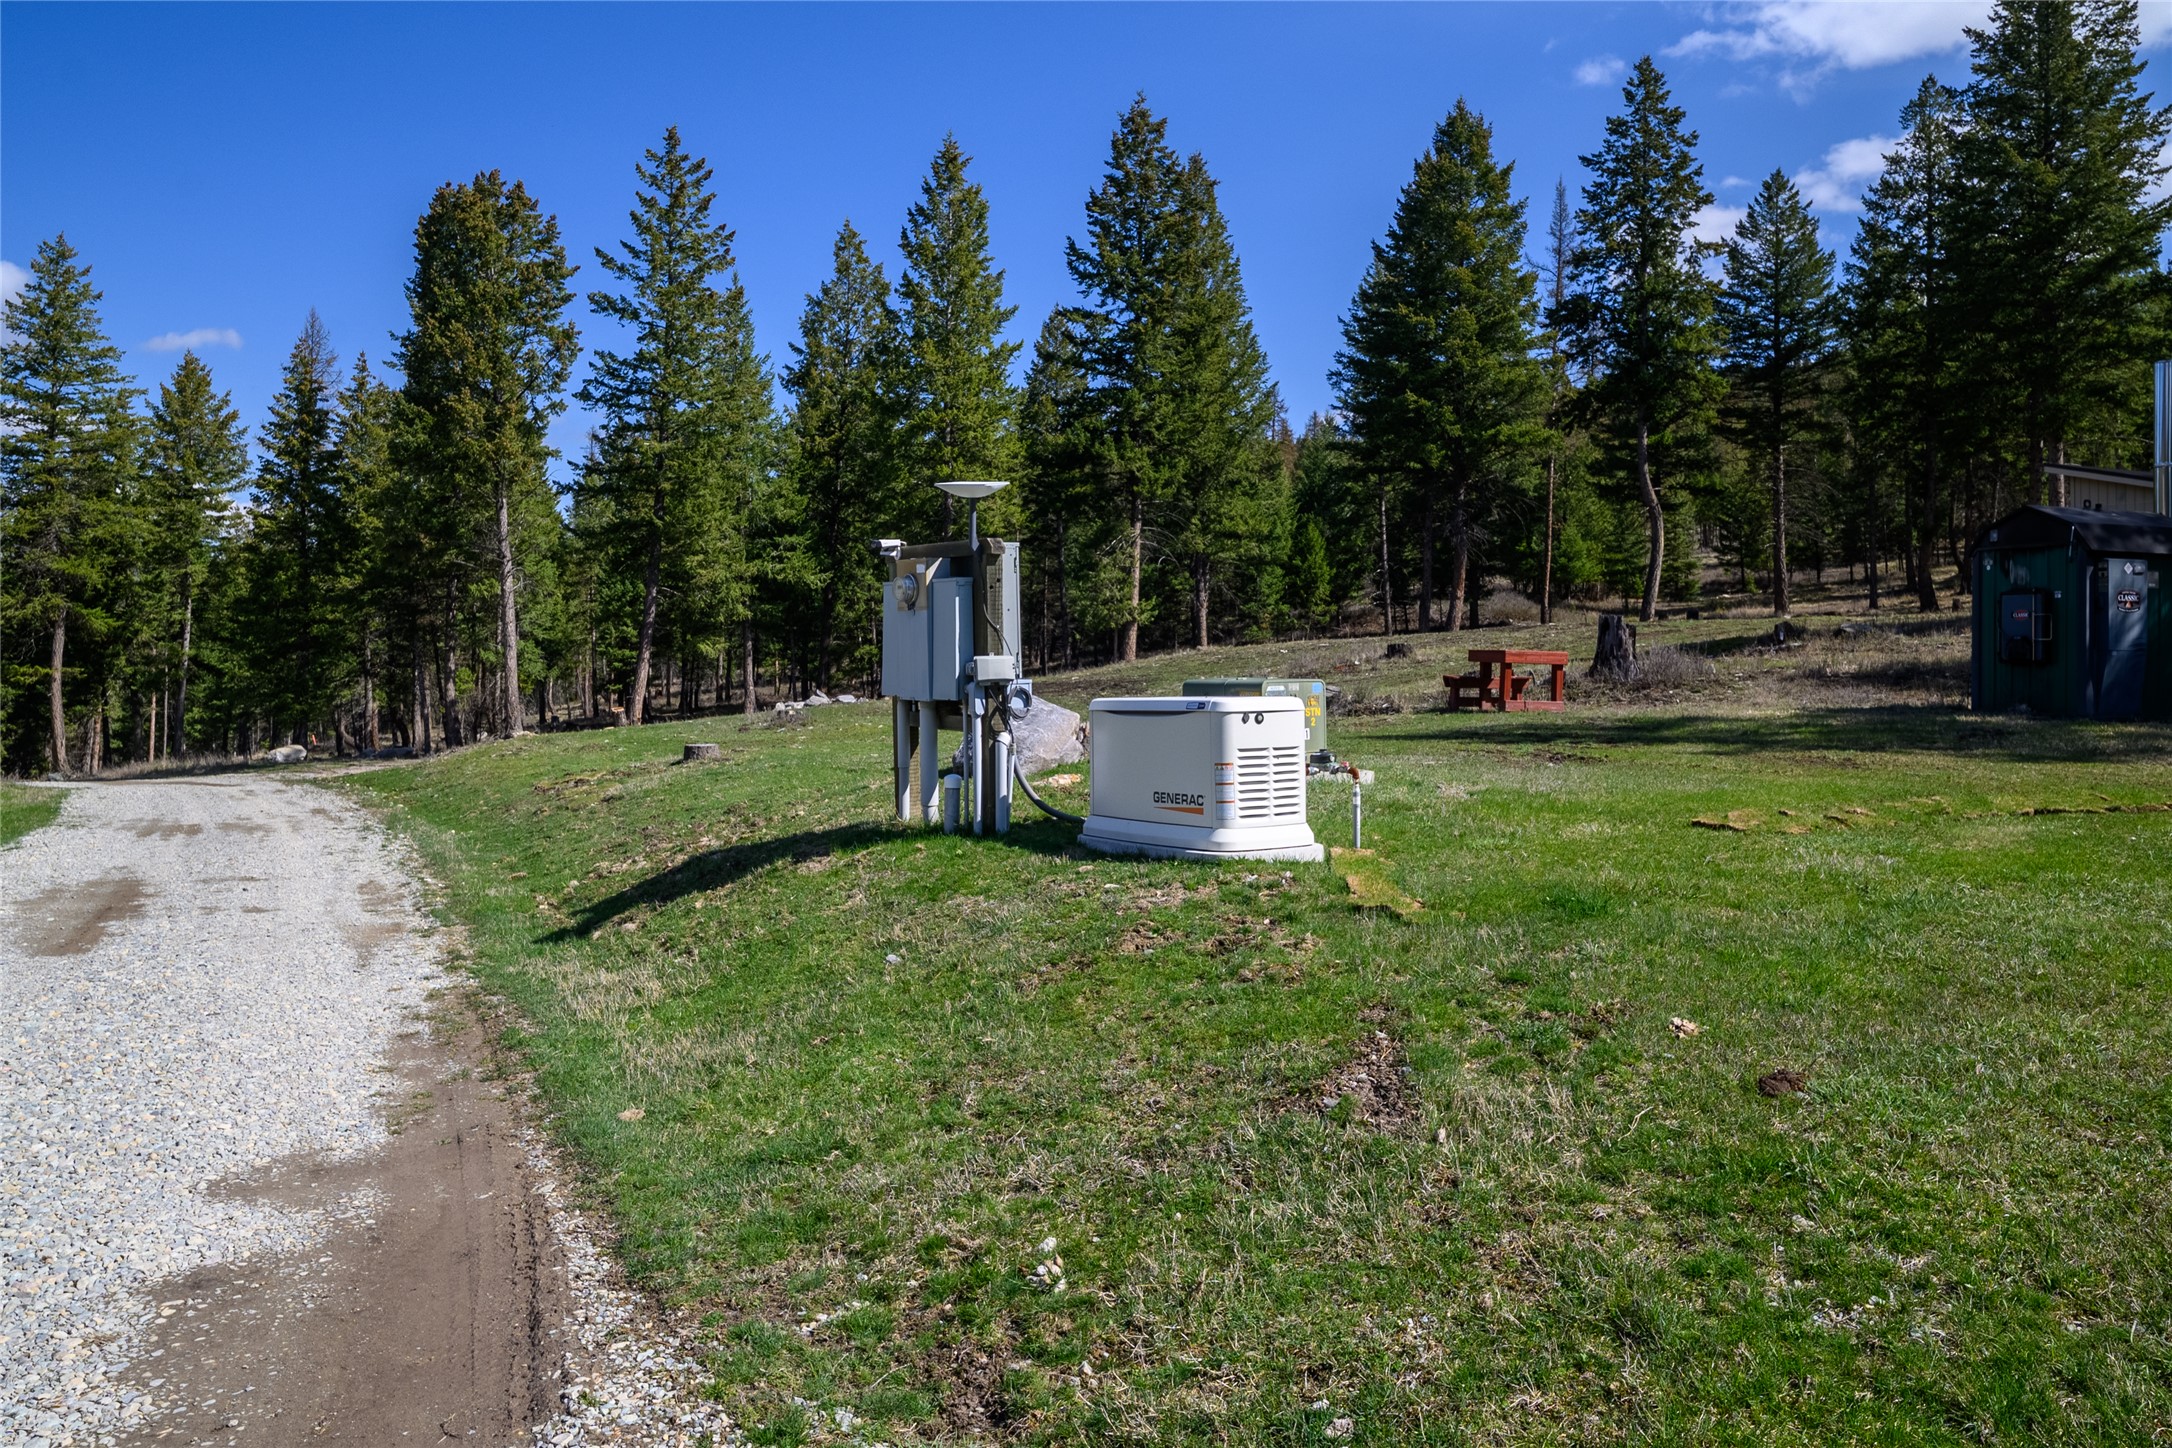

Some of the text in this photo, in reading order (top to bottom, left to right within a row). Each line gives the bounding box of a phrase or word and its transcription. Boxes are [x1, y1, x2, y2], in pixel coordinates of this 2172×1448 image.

[2117, 594, 2139, 602] CLASSIC
[1305, 707, 1321, 717] STN
[1310, 717, 1316, 727] 2
[1153, 791, 1205, 806] GENERAC
